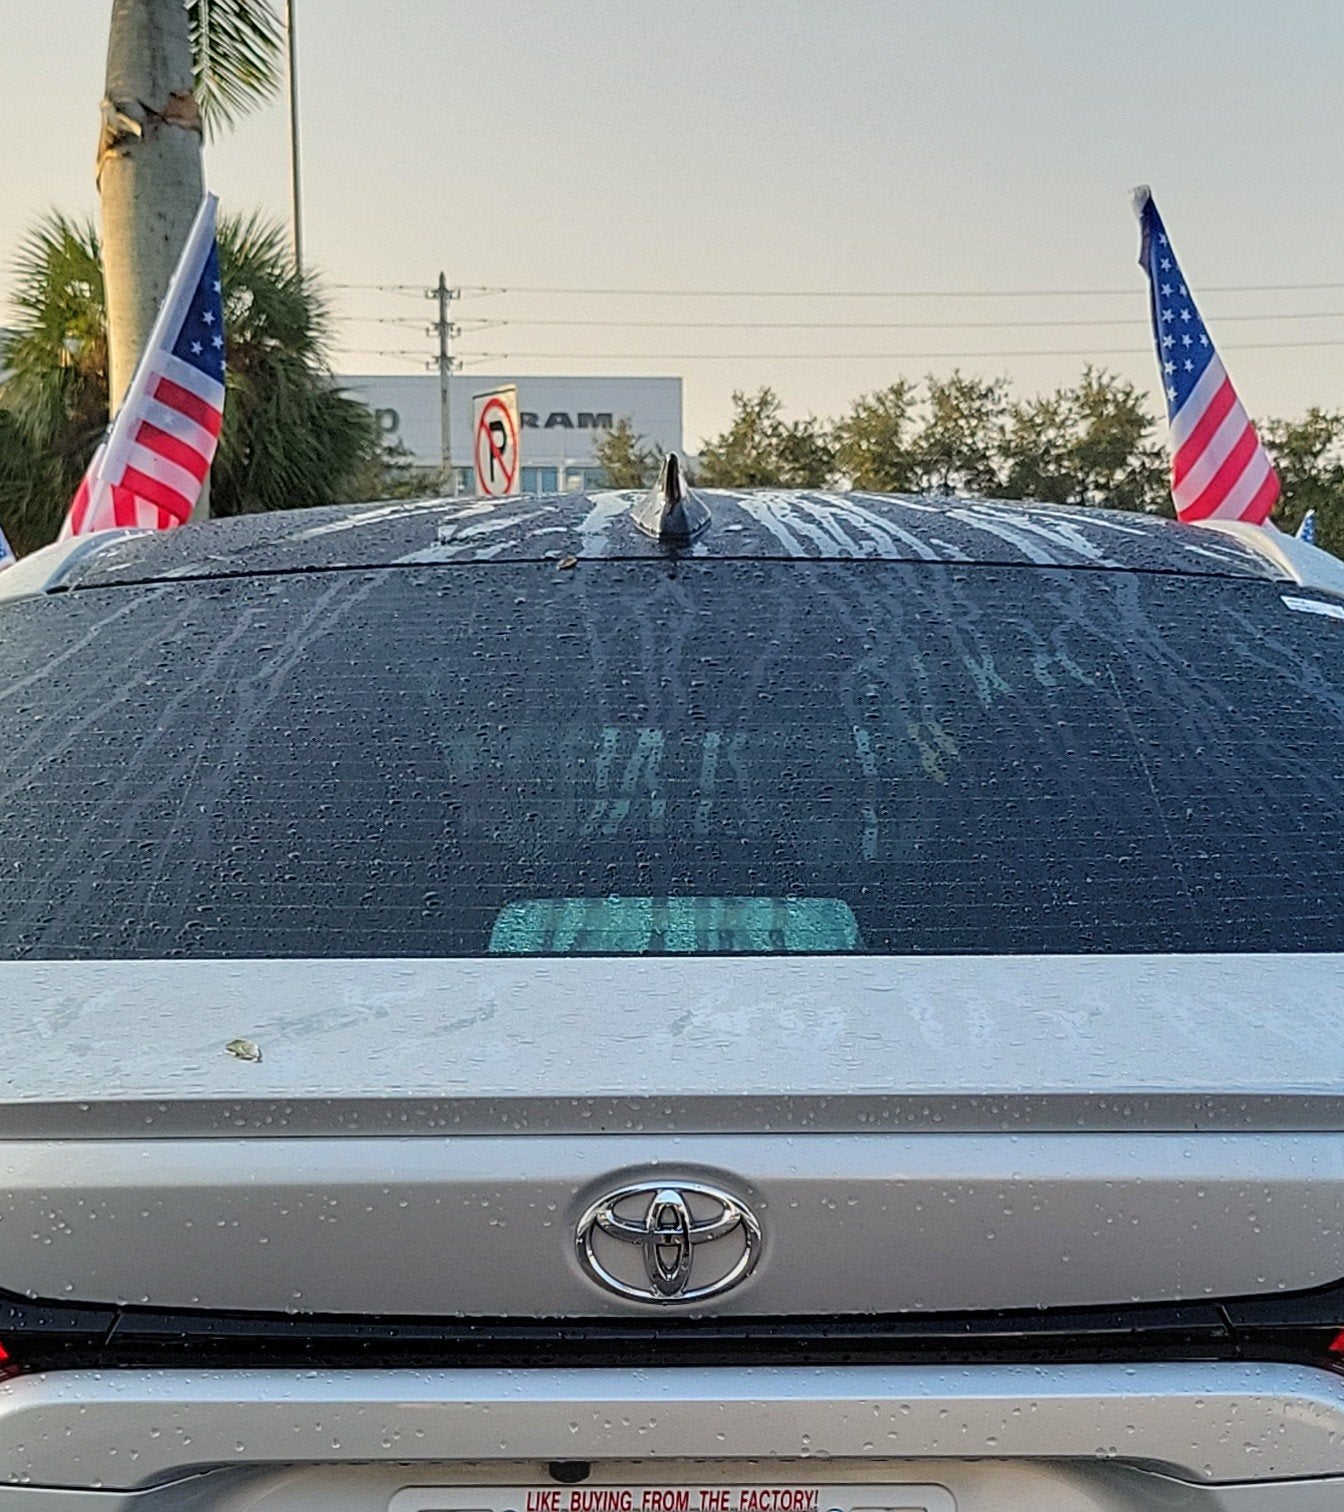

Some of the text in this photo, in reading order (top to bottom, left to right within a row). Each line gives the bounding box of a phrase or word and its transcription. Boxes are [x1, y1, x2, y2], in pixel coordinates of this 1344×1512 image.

[519, 411, 613, 429] RAM
[526, 1489, 819, 1512] LIKE BUYING FROM THE FACTORY!
